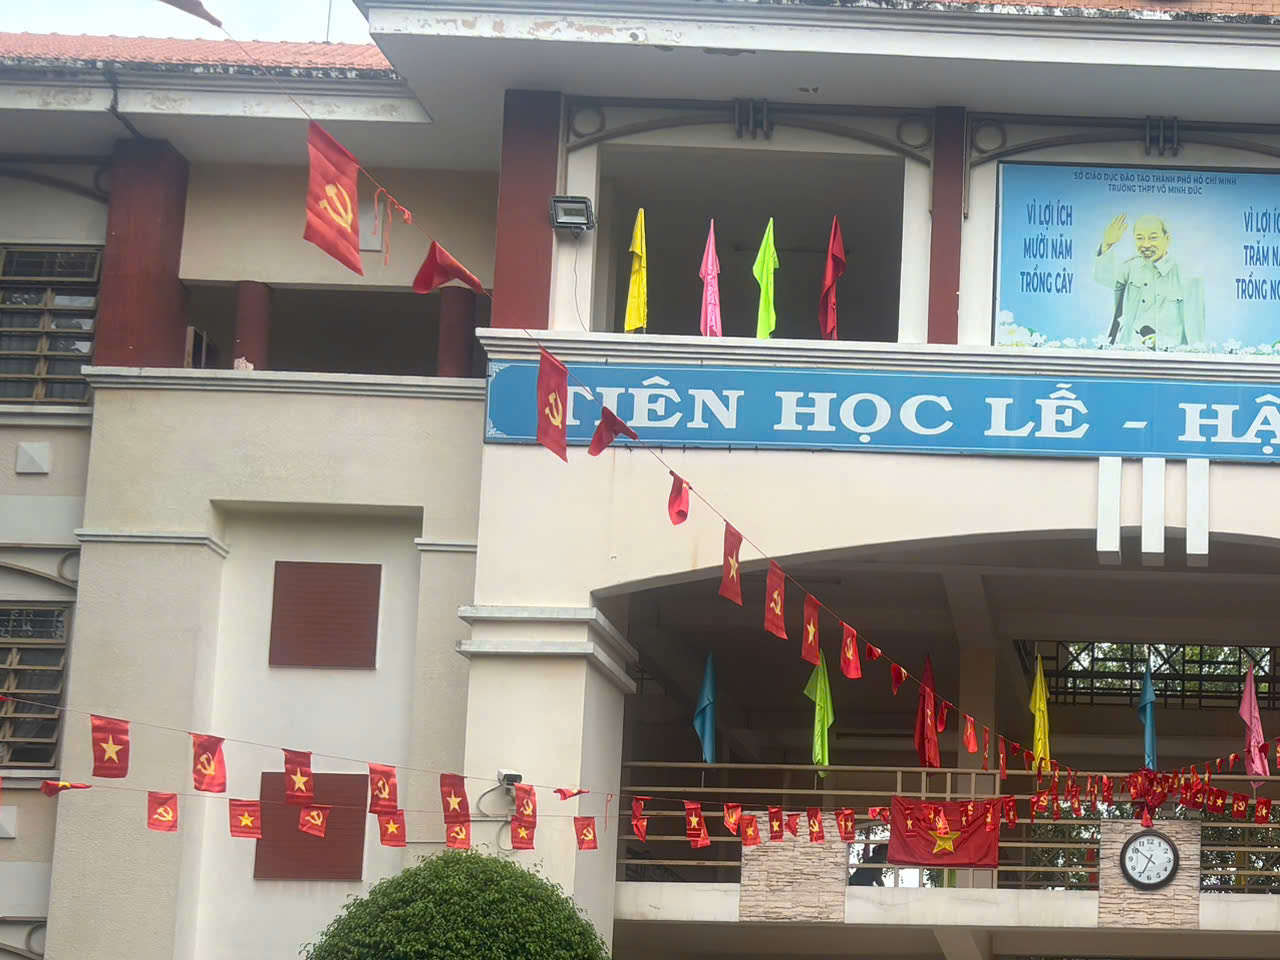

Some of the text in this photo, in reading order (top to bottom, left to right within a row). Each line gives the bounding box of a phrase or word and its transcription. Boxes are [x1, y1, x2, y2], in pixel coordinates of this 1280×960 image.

[1108, 183, 1136, 192] TRƯỜNG
[1168, 186, 1186, 194] MINH
[1218, 177, 1237, 185] MINH
[1027, 198, 1072, 229] VÌ LỢI ÍCH
[1244, 206, 1254, 232] VÌ
[1256, 211, 1271, 238] LỢI
[1024, 232, 1072, 260] MƯỜI NĂM
[1244, 241, 1270, 266] TRĂM
[1020, 264, 1073, 294] TRỒNG CÂY
[1236, 272, 1268, 300] TRỒNG
[566, 376, 745, 429] TIÊN
[773, 390, 954, 443] HỌC
[984, 382, 1091, 439] LỄ
